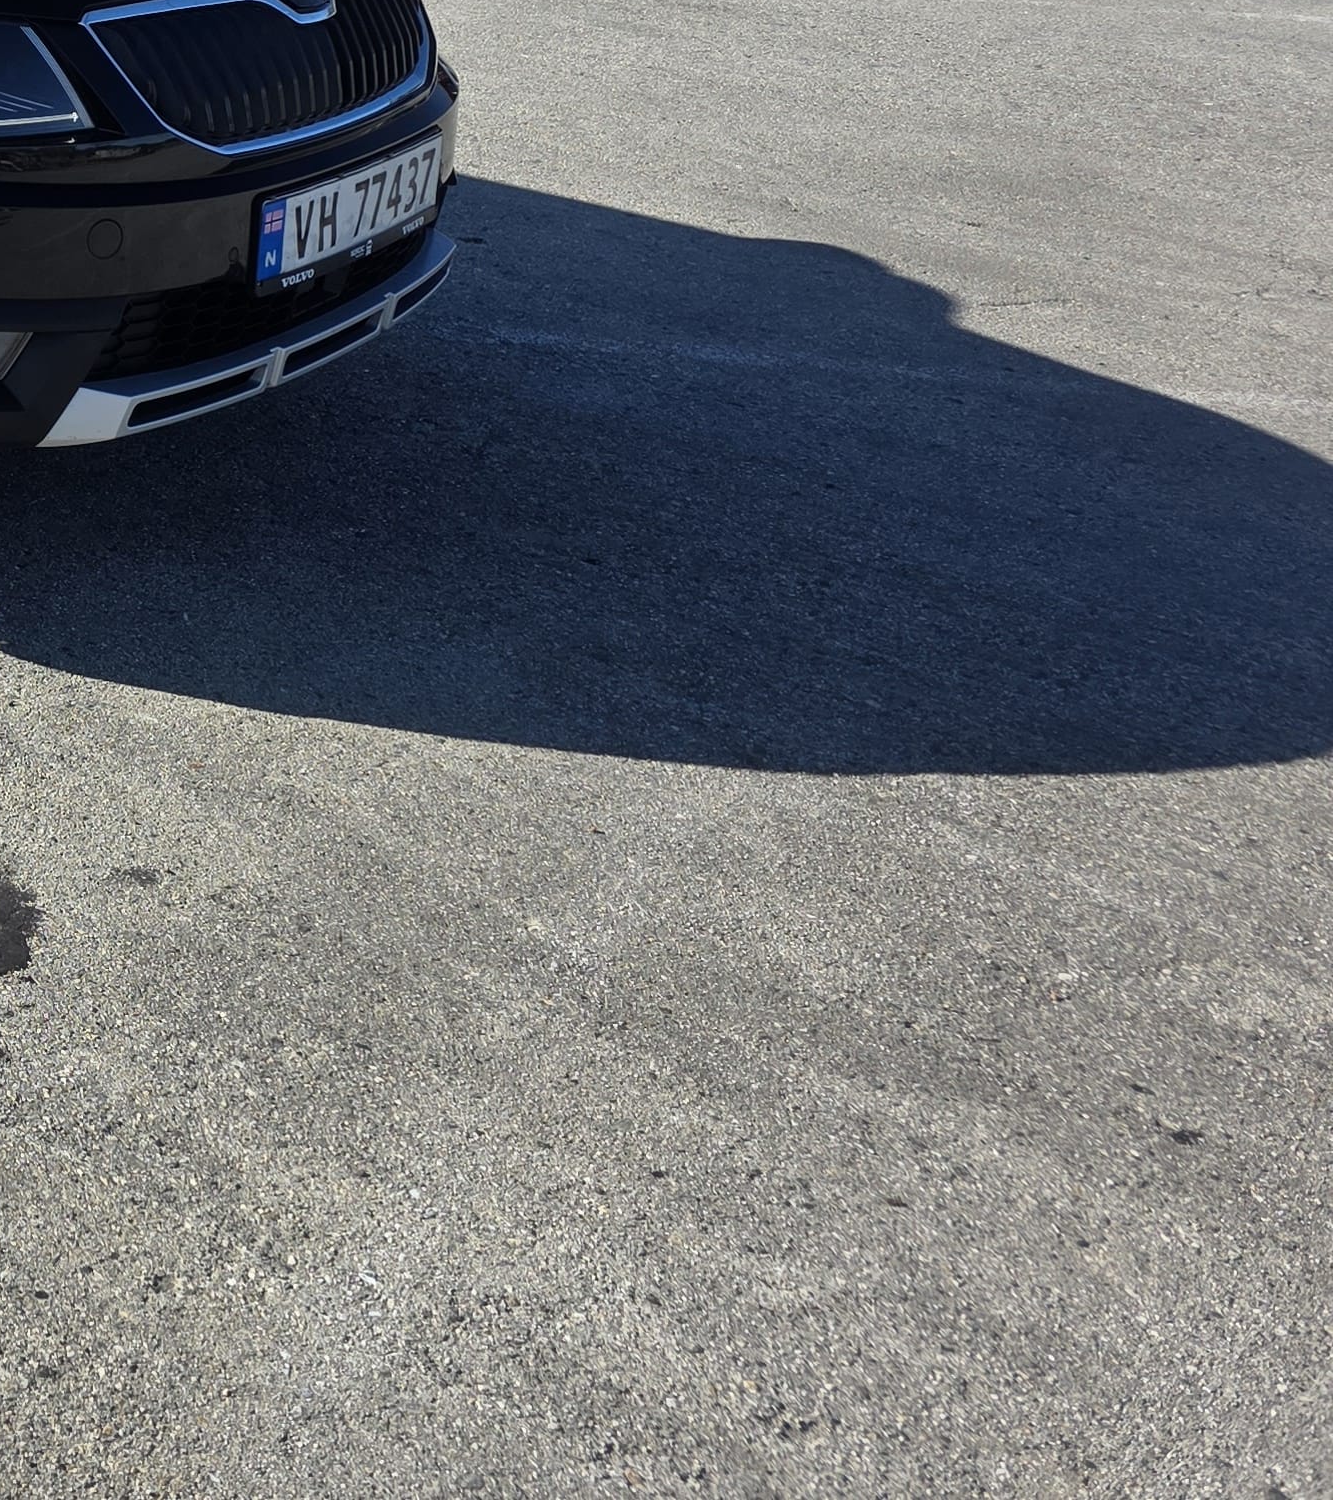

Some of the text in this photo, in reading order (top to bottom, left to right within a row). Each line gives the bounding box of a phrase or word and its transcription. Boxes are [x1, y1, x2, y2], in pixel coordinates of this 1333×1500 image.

[295, 148, 436, 259] VH 77437
[402, 216, 424, 235] VOLVO
[264, 250, 277, 268] N
[282, 269, 315, 288] VOLVO
